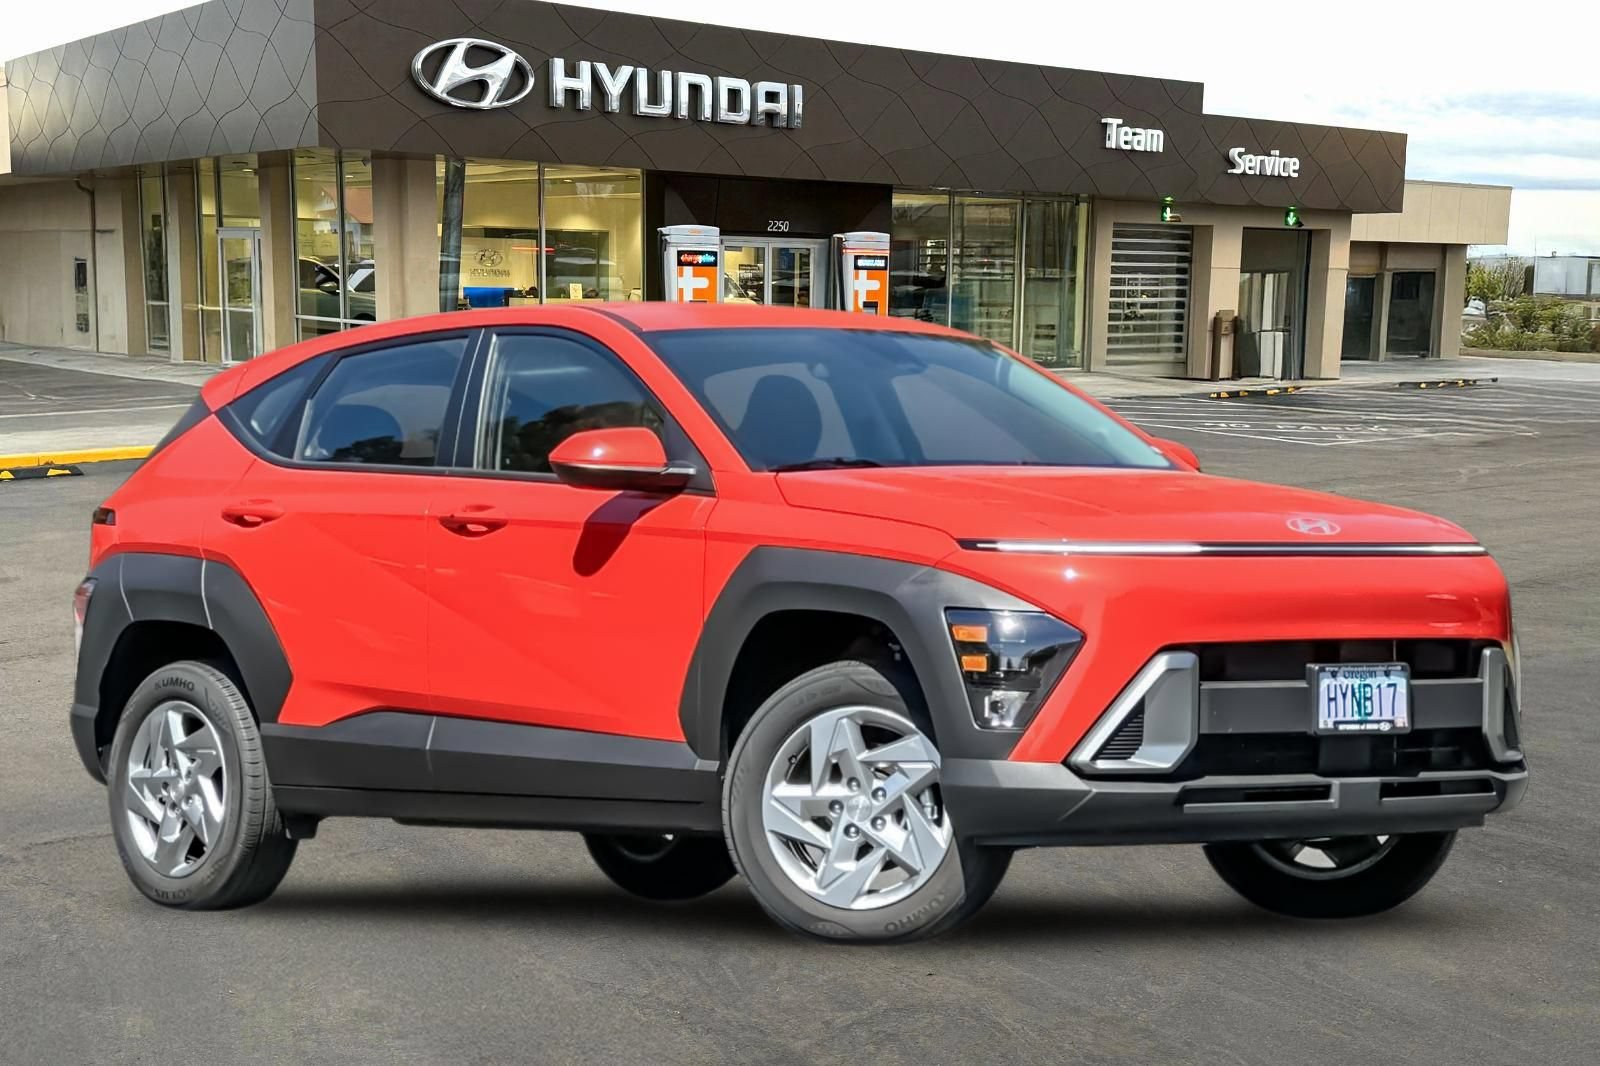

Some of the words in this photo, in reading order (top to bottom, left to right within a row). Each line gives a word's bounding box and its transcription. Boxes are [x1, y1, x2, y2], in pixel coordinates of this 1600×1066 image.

[549, 57, 803, 129] HYUNDAI
[1101, 117, 1165, 153] Team
[1227, 147, 1300, 178] Service
[767, 220, 790, 232] 2250
[1326, 682, 1398, 719] HYNB17
